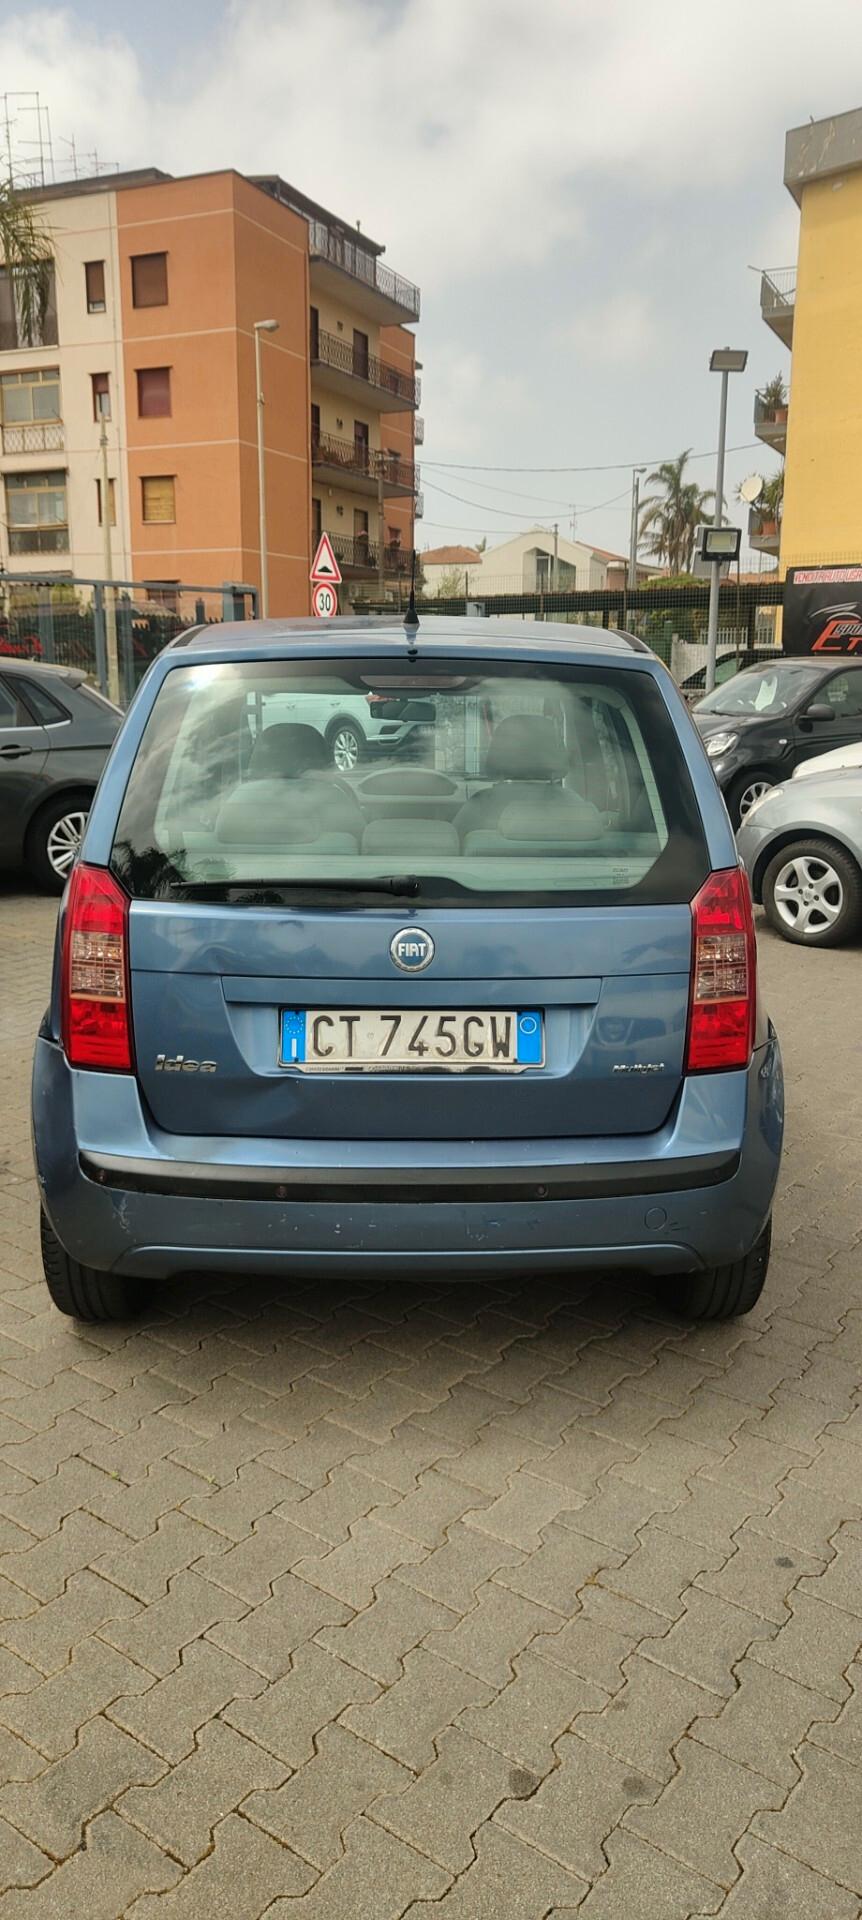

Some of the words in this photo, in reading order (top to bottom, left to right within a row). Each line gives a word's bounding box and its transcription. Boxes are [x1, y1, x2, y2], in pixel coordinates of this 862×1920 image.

[319, 593, 331, 611] 30
[398, 942, 426, 957] FIAT
[312, 1015, 361, 1058] CT
[379, 1015, 512, 1058] 745GW
[155, 1054, 217, 1073] Idea
